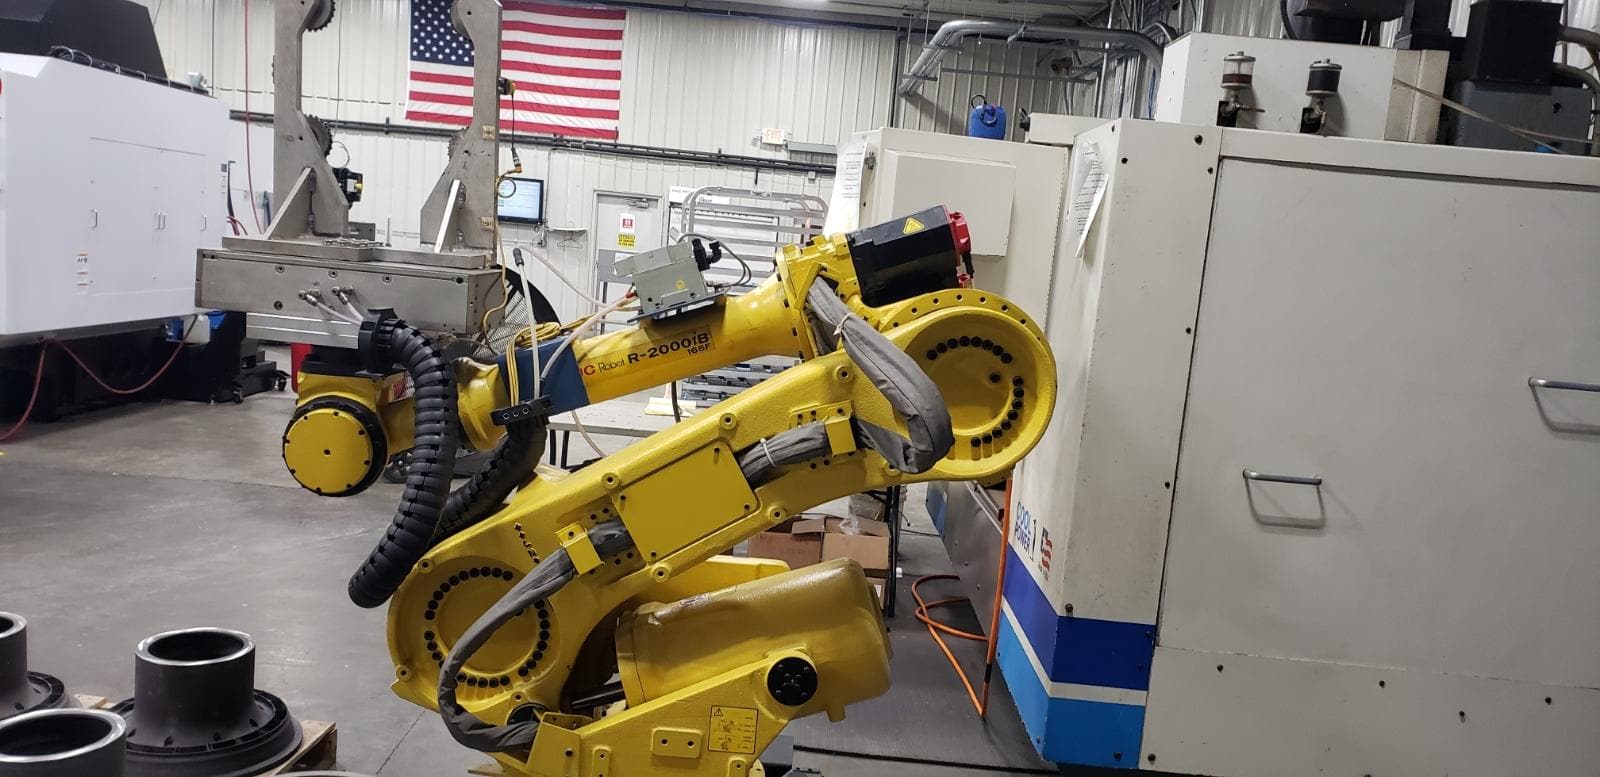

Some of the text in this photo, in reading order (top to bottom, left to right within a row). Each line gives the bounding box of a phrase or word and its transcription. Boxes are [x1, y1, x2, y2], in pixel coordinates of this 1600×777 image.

[598, 359, 625, 373] Robot
[627, 331, 710, 364] R-2000iB
[687, 342, 711, 356] 165F
